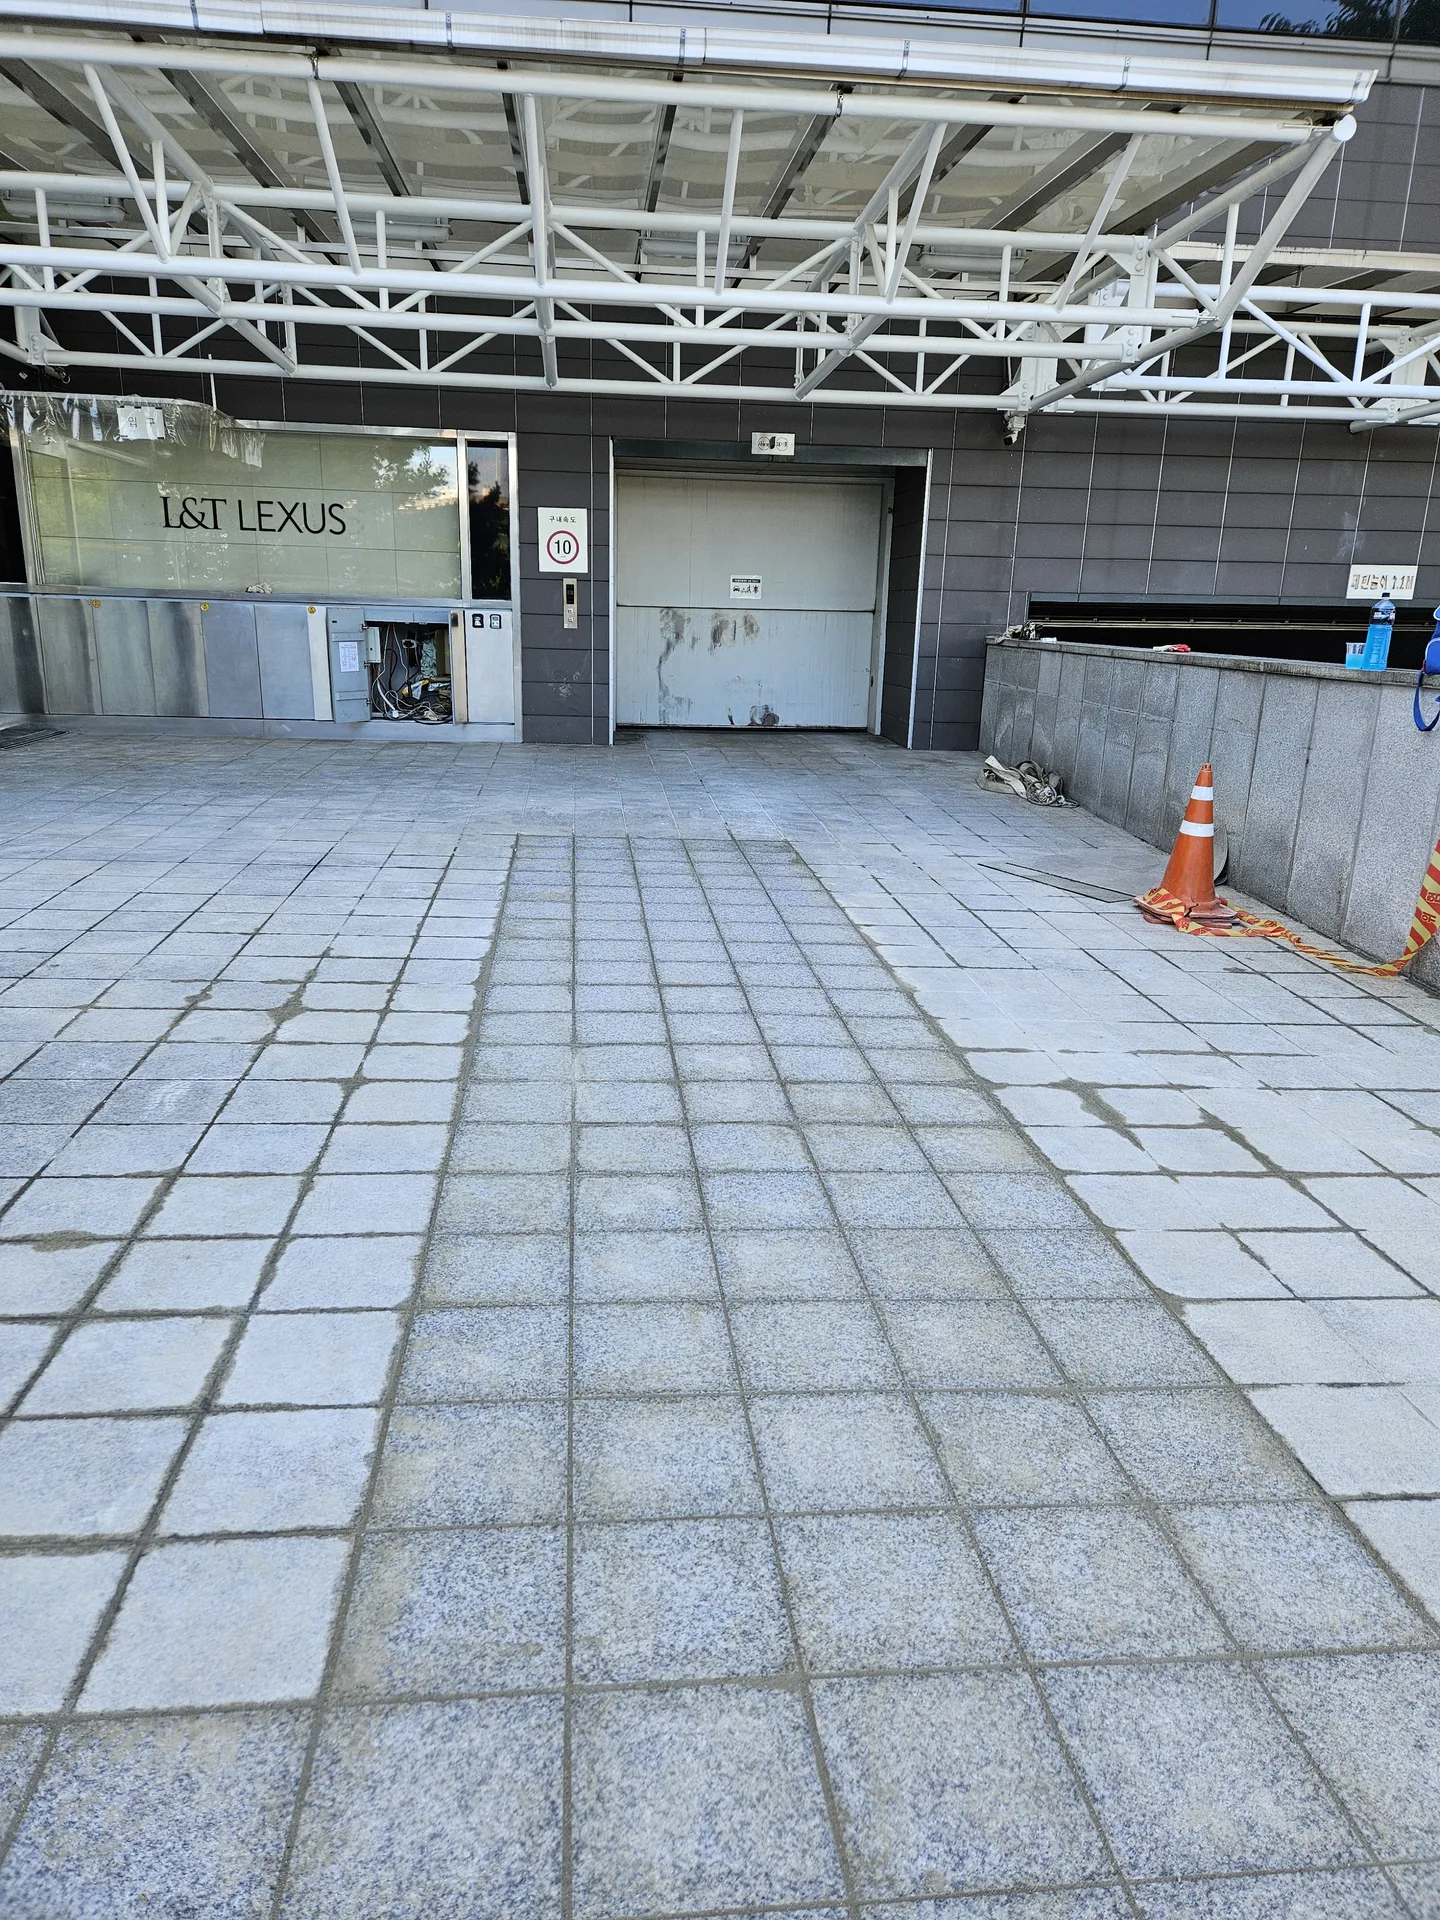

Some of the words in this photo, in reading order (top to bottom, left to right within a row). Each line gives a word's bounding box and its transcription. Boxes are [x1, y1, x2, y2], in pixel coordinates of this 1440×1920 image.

[159, 496, 227, 530] L&T
[238, 499, 346, 535] LEXUS
[549, 515, 577, 524] 구내속도
[554, 539, 572, 555] 10
